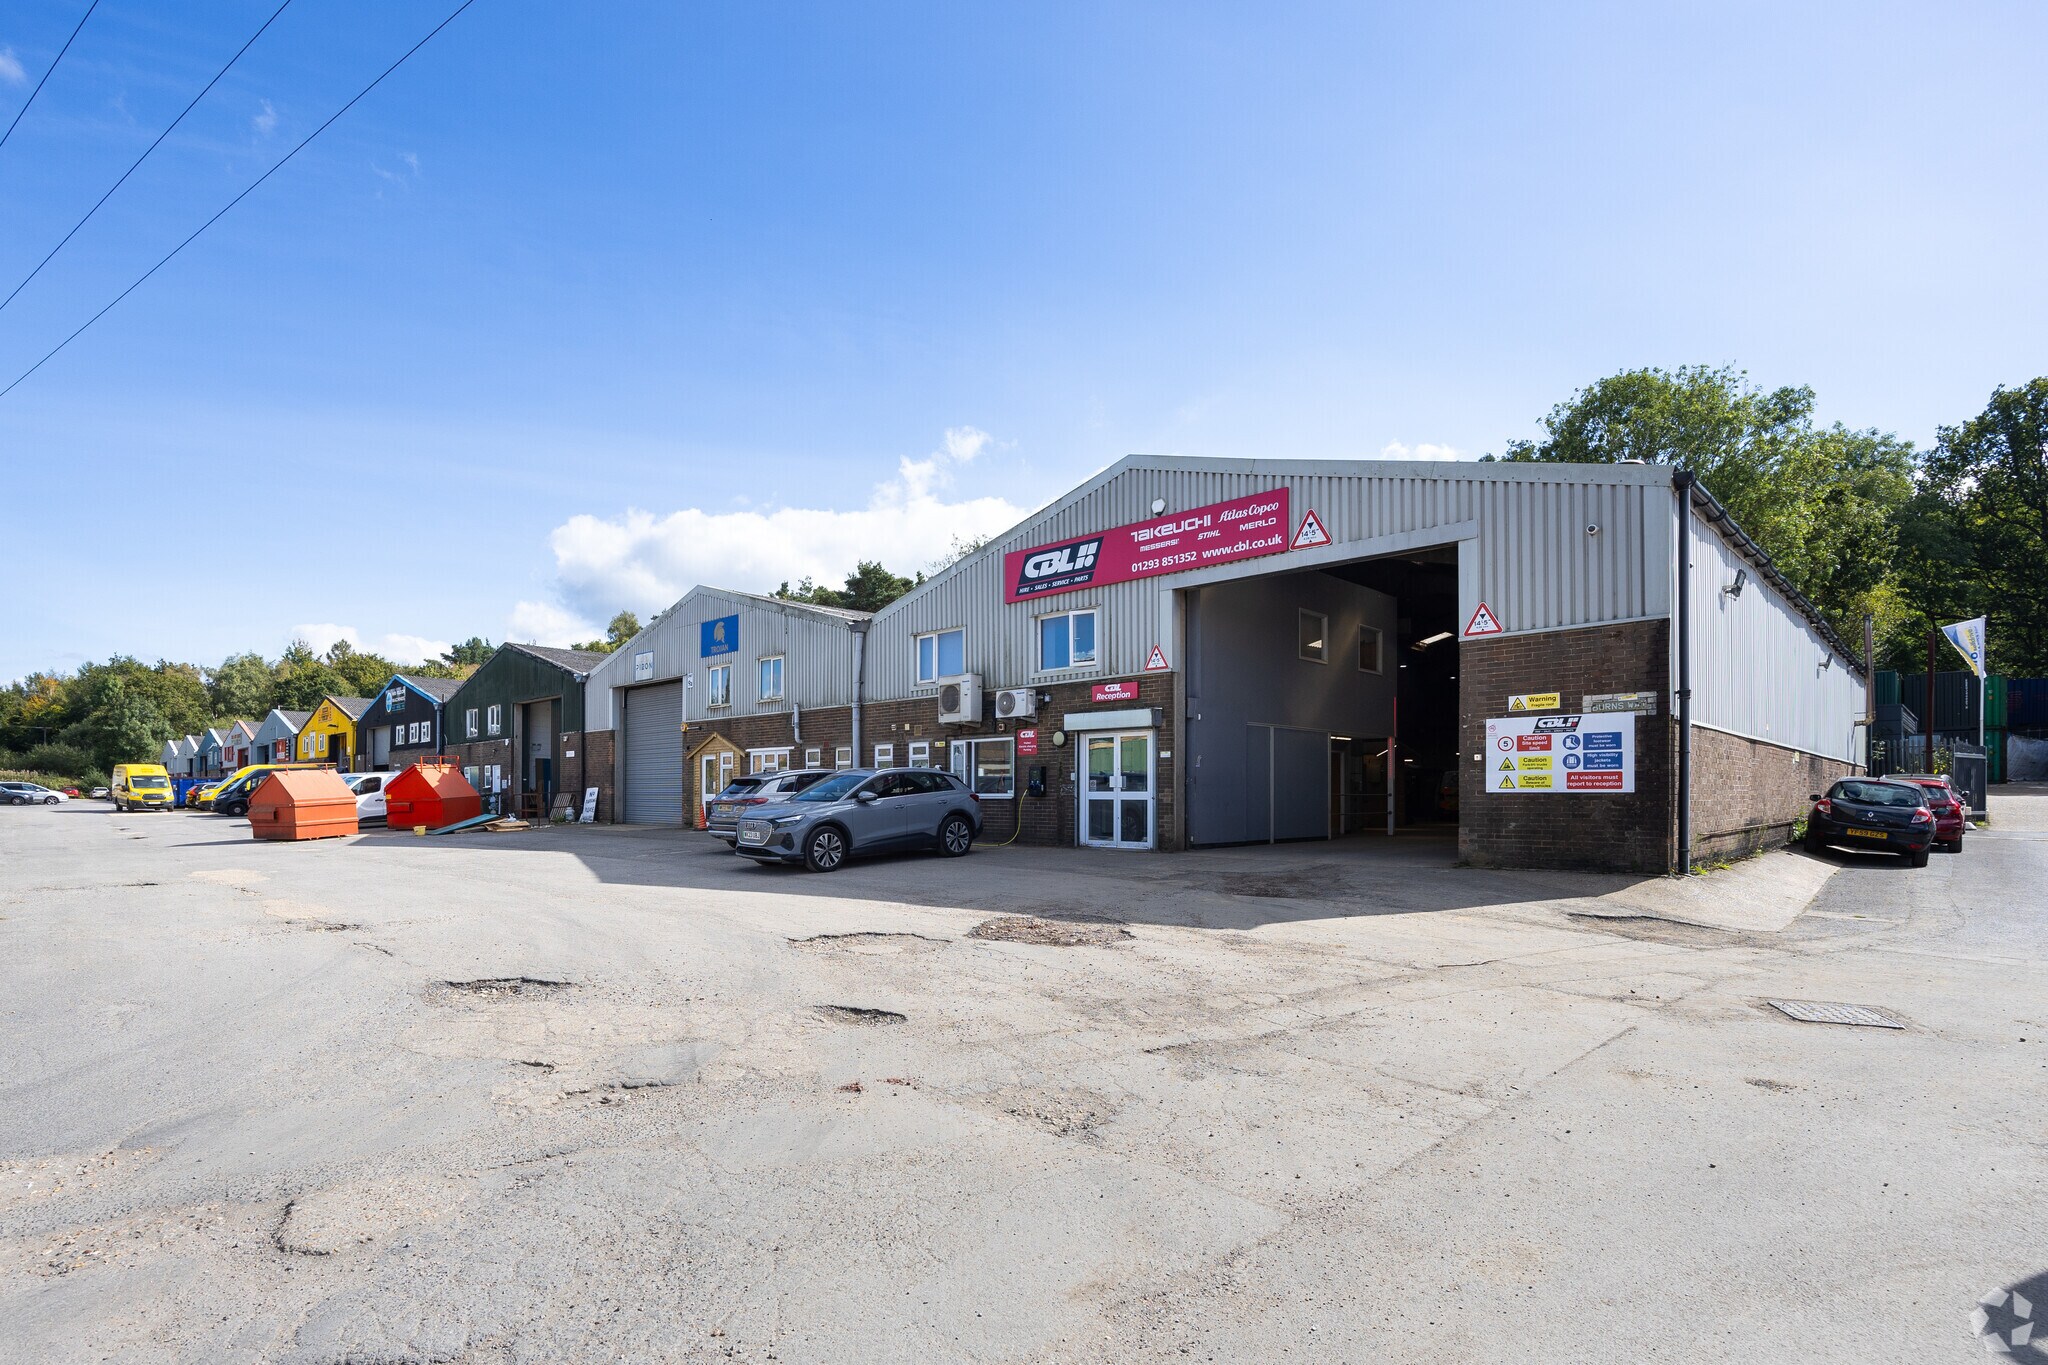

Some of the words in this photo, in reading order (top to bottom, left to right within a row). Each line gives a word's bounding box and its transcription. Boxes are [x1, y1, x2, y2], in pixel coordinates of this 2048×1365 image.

[1218, 507, 1247, 523] Atlas
[1248, 501, 1279, 516] Copco
[1239, 517, 1277, 531] MERLO
[1197, 529, 1221, 540] STIHL
[1131, 557, 1160, 573] 01293
[1161, 551, 1197, 567] 851352
[1202, 533, 1283, 559] www.cbl.co.uk
[1051, 579, 1070, 588] SERVICE
[1073, 574, 1089, 583] PARTS
[711, 644, 729, 653] TROJAN
[1104, 683, 1122, 692] CBL
[1096, 691, 1131, 701] Reception
